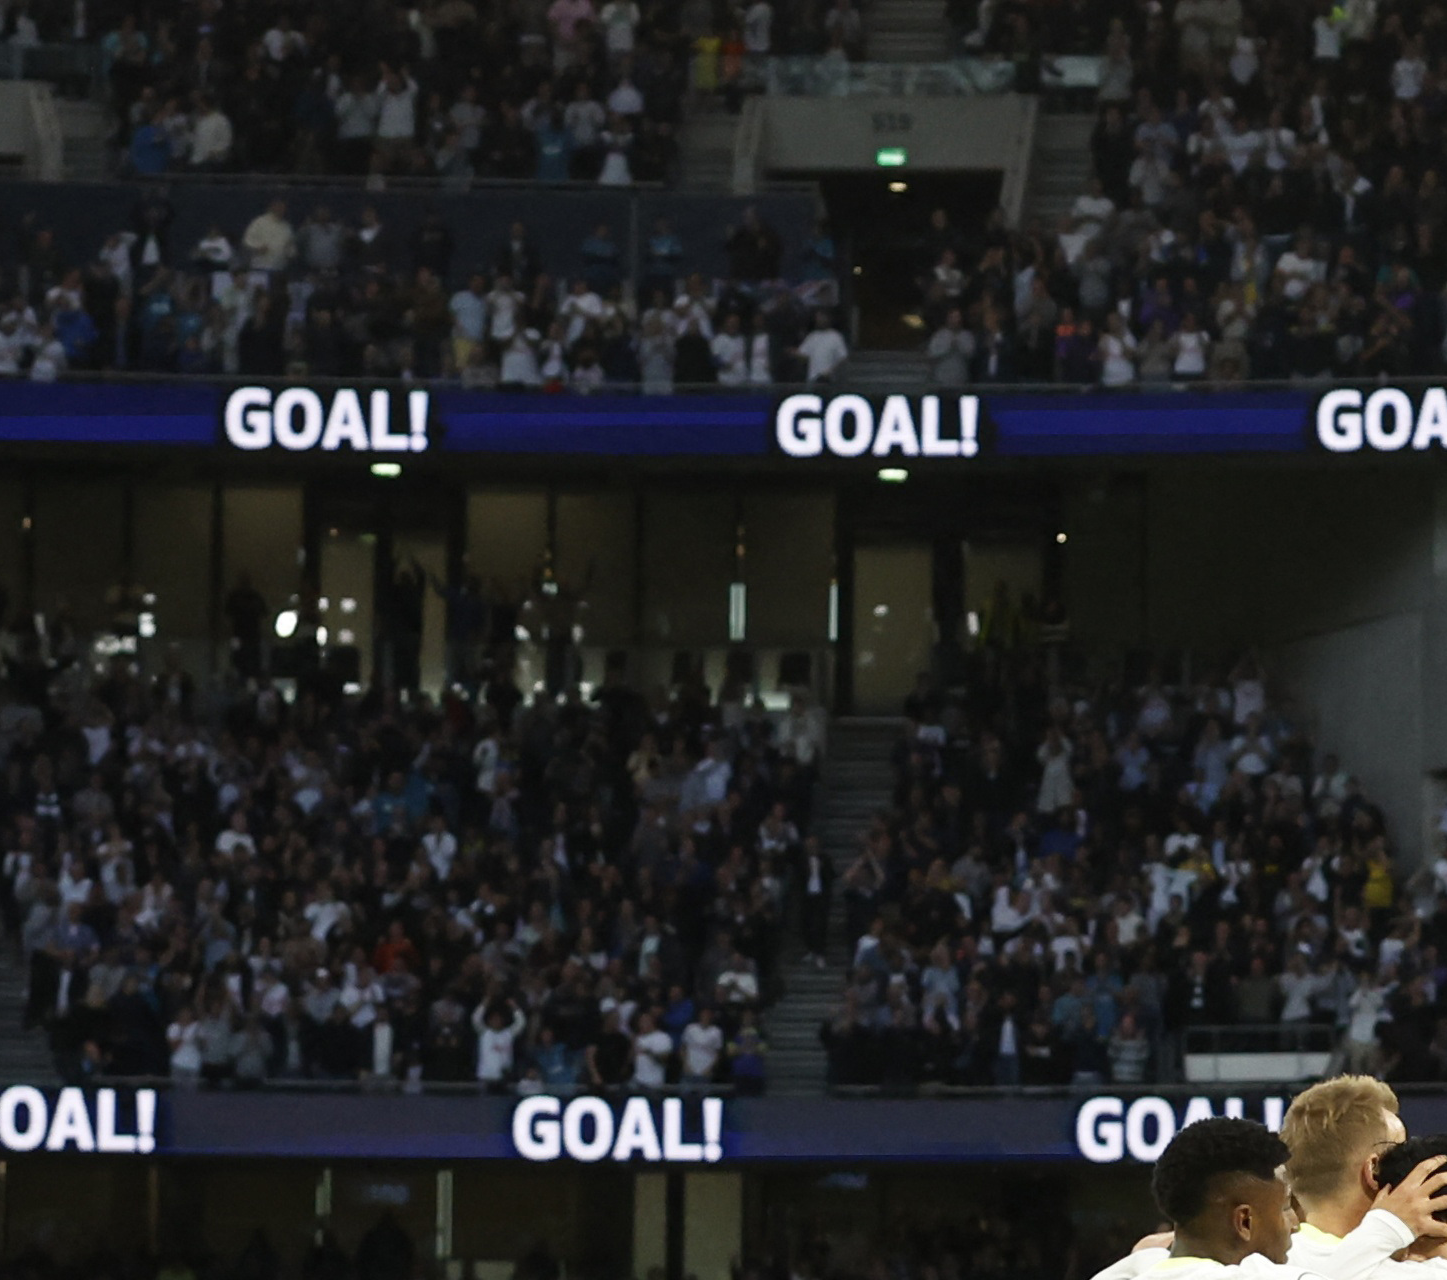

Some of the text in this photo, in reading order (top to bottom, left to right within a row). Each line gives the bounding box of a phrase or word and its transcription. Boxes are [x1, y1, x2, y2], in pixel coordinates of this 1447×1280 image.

[225, 387, 428, 451] GOAL!
[776, 394, 978, 456] GOAL!
[512, 1095, 722, 1162] GOAL!
